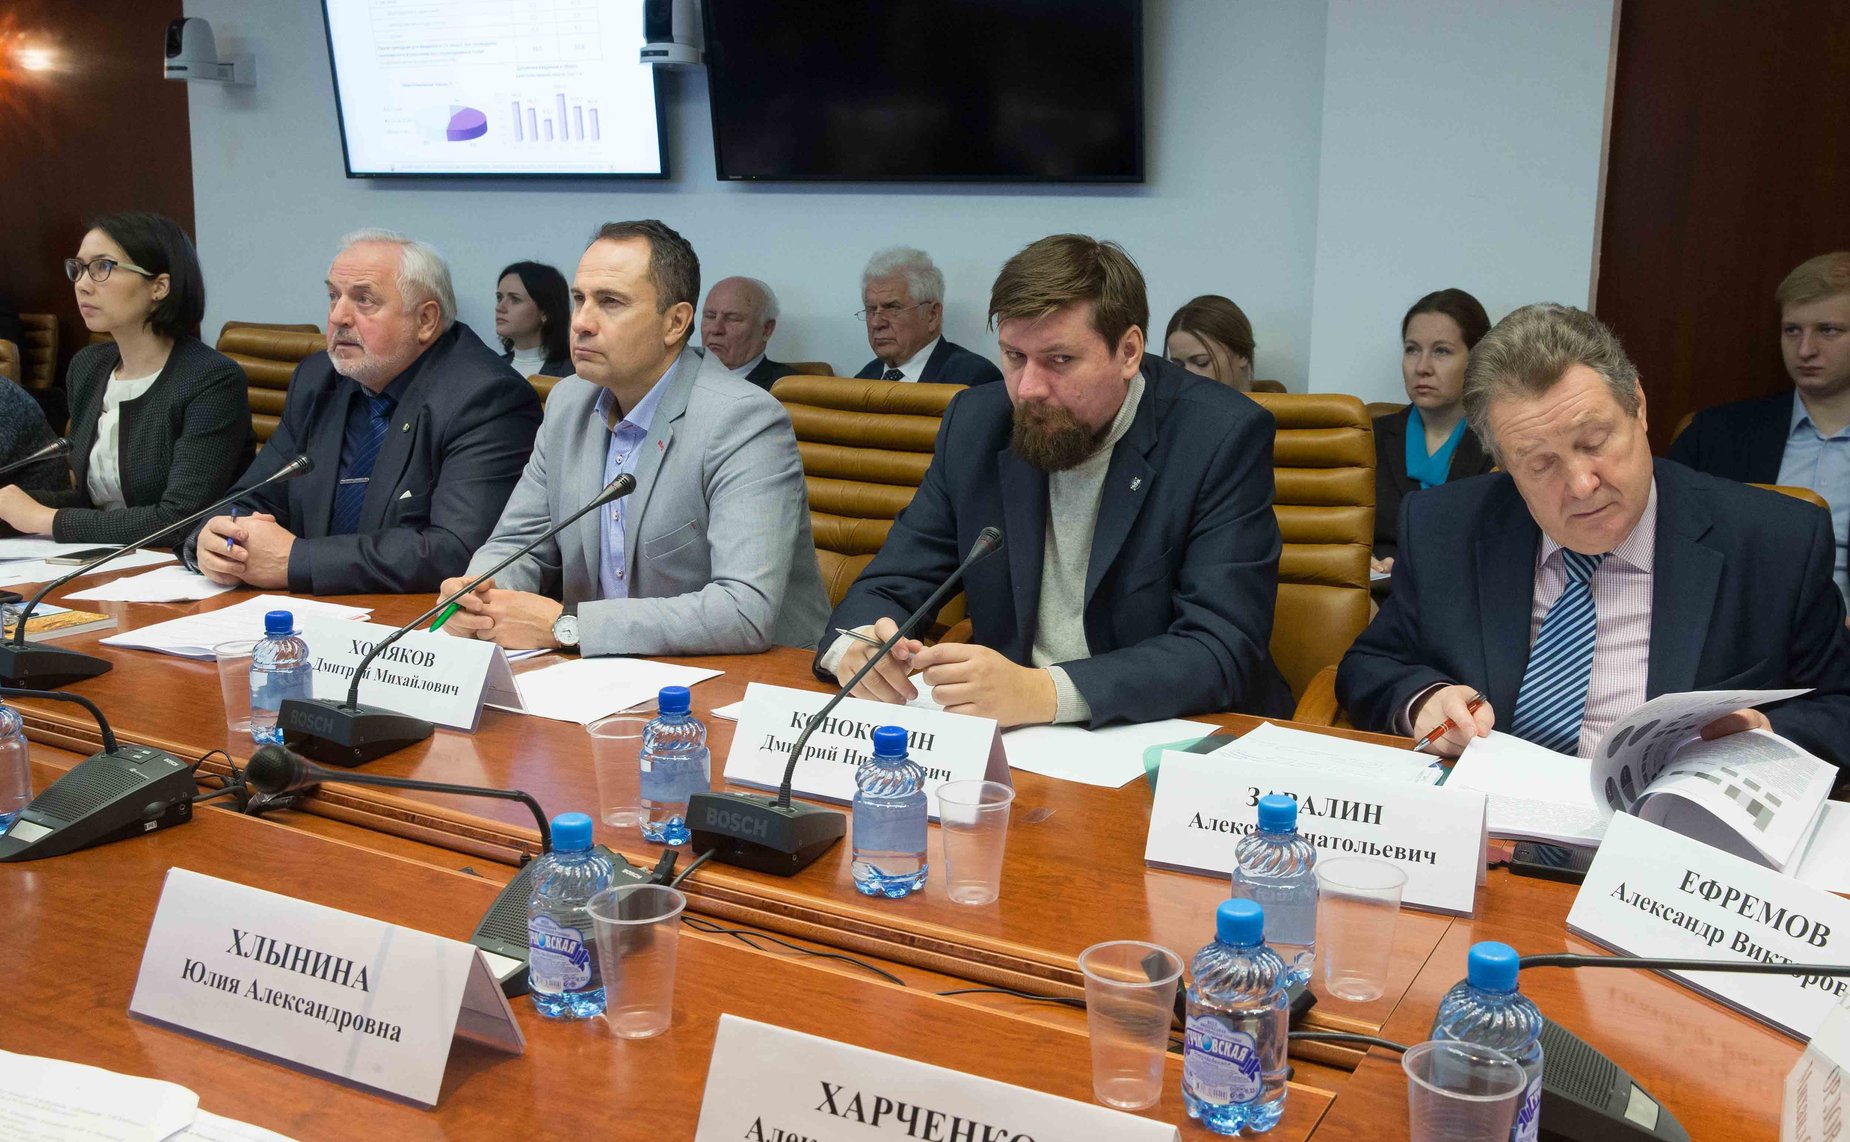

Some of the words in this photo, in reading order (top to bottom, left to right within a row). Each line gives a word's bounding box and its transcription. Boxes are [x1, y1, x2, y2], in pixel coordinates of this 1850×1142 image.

[312, 657, 371, 680] Дмитрй
[374, 668, 459, 696] Михайлович
[290, 709, 334, 733] BOSCH
[790, 711, 935, 751] КОНОКИН
[760, 734, 838, 762] Дмирий
[706, 807, 768, 838] BOSCH
[1246, 786, 1384, 826] ЗАЛИН
[1300, 832, 1437, 865] натольевич
[1610, 881, 1725, 947] Александр
[1678, 869, 1831, 948] ЕФРЕМОВ
[226, 928, 370, 993] ХЛЫНИНА
[181, 957, 241, 995] Юлия
[244, 978, 402, 1043] Александровна
[815, 1080, 1036, 1142] ХАРЧЕНК
